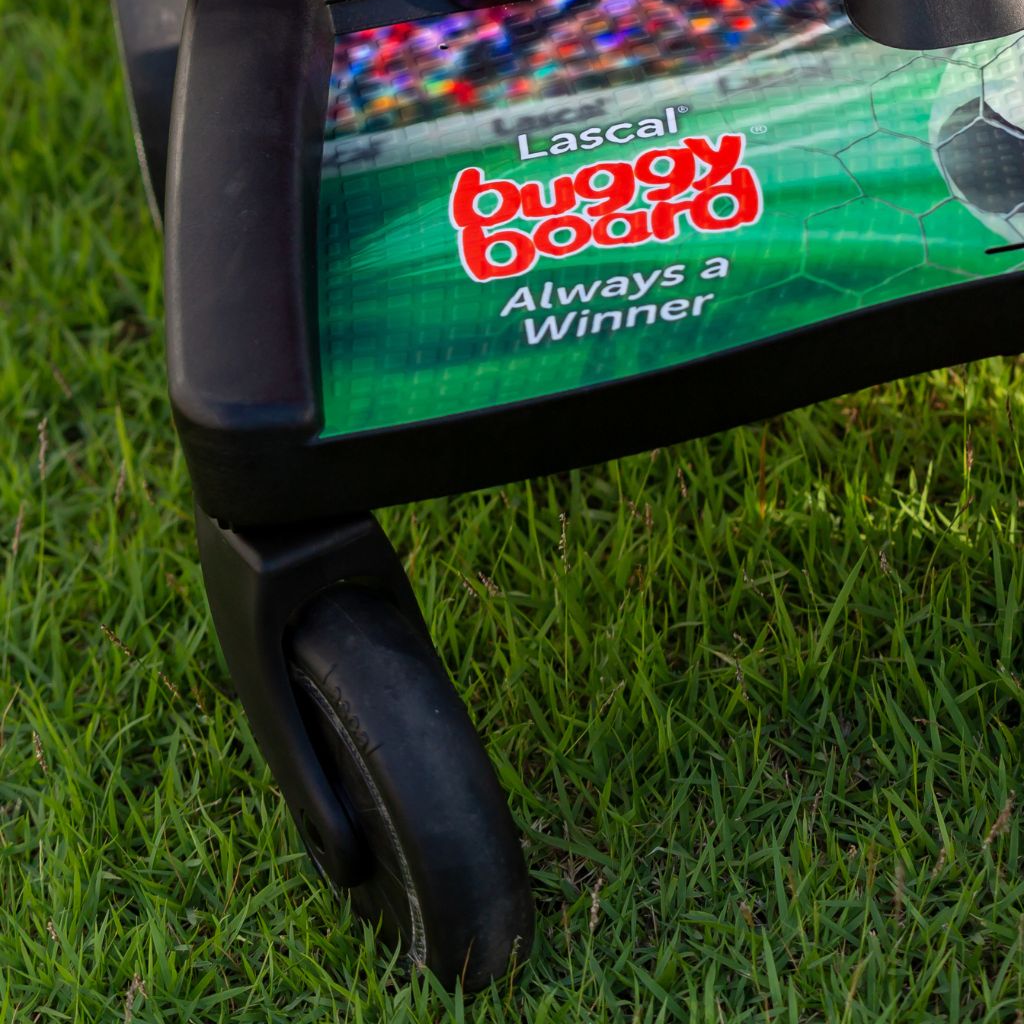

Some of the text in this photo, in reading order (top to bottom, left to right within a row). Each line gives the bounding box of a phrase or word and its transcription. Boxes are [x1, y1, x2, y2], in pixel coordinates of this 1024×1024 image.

[450, 134, 746, 229] buggy
[458, 166, 763, 282] board
[501, 257, 730, 317] Always a
[523, 293, 715, 345] Winner
